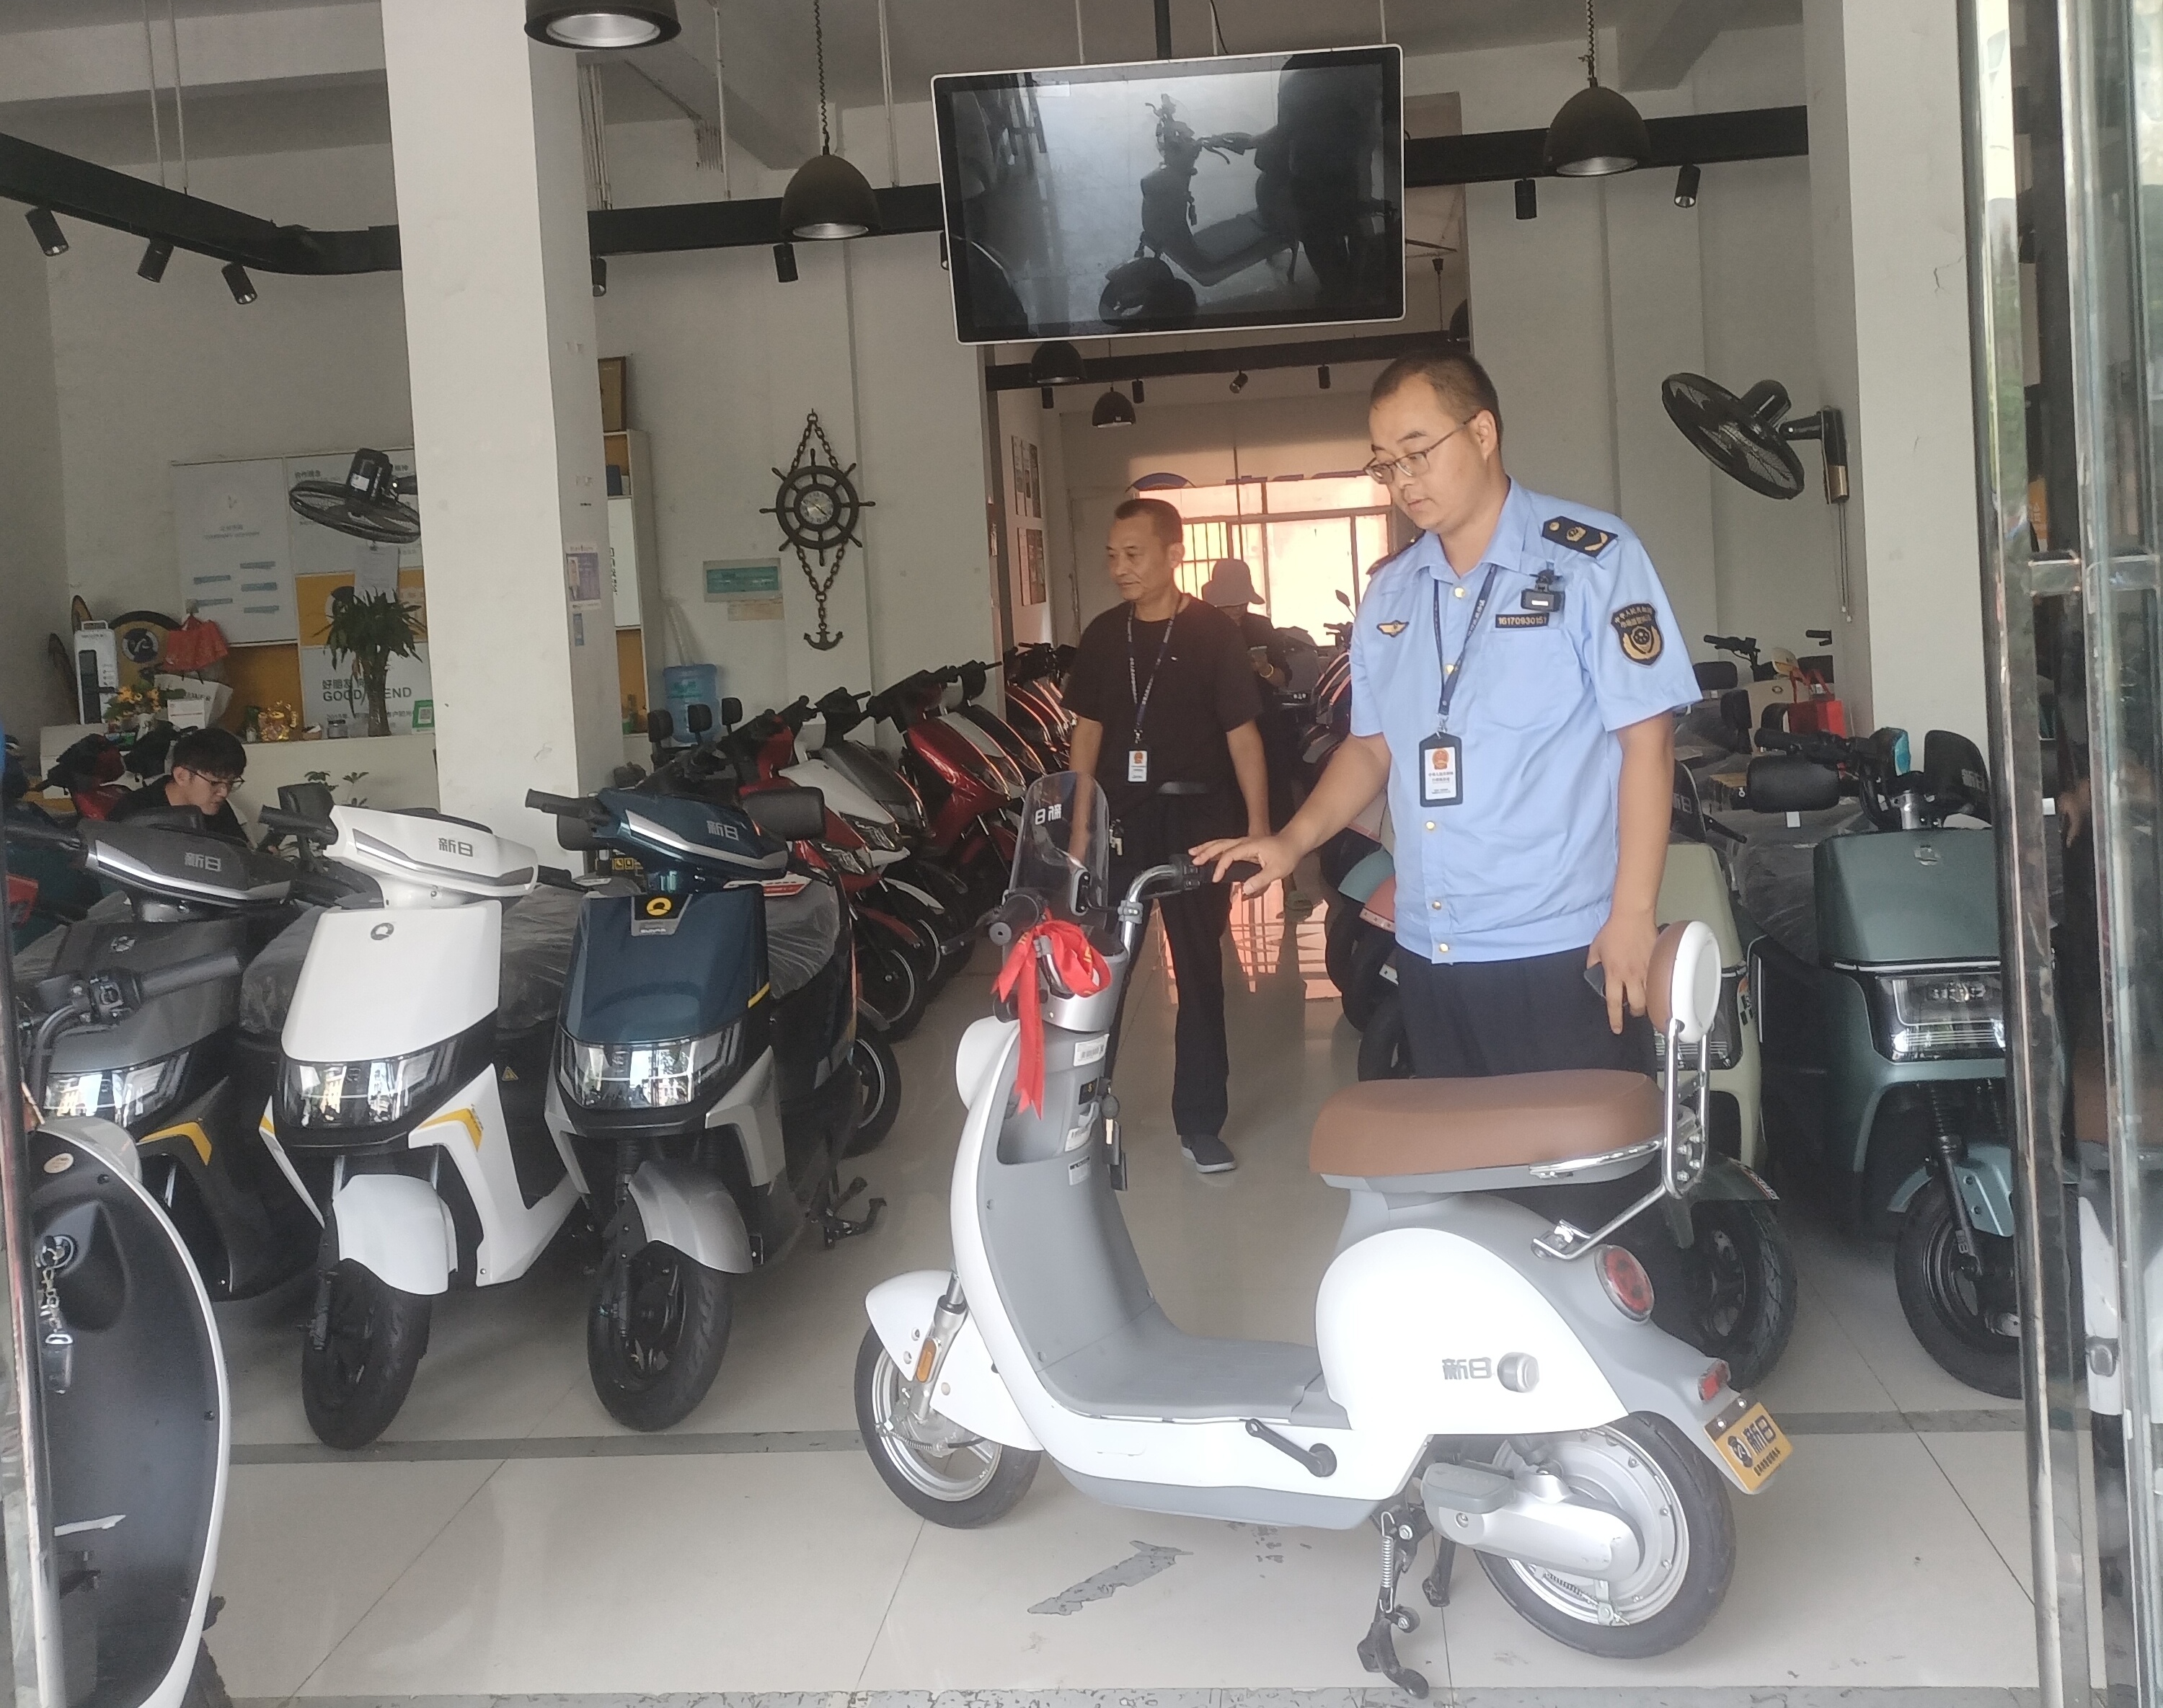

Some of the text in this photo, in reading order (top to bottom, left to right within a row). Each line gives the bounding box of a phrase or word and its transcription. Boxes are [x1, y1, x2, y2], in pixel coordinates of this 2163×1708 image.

[707, 820, 740, 841] 新日
[438, 837, 473, 857] 新日
[184, 851, 222, 872] 新日
[1441, 1357, 1492, 1380] 新日
[1741, 1415, 1777, 1456] 新日
